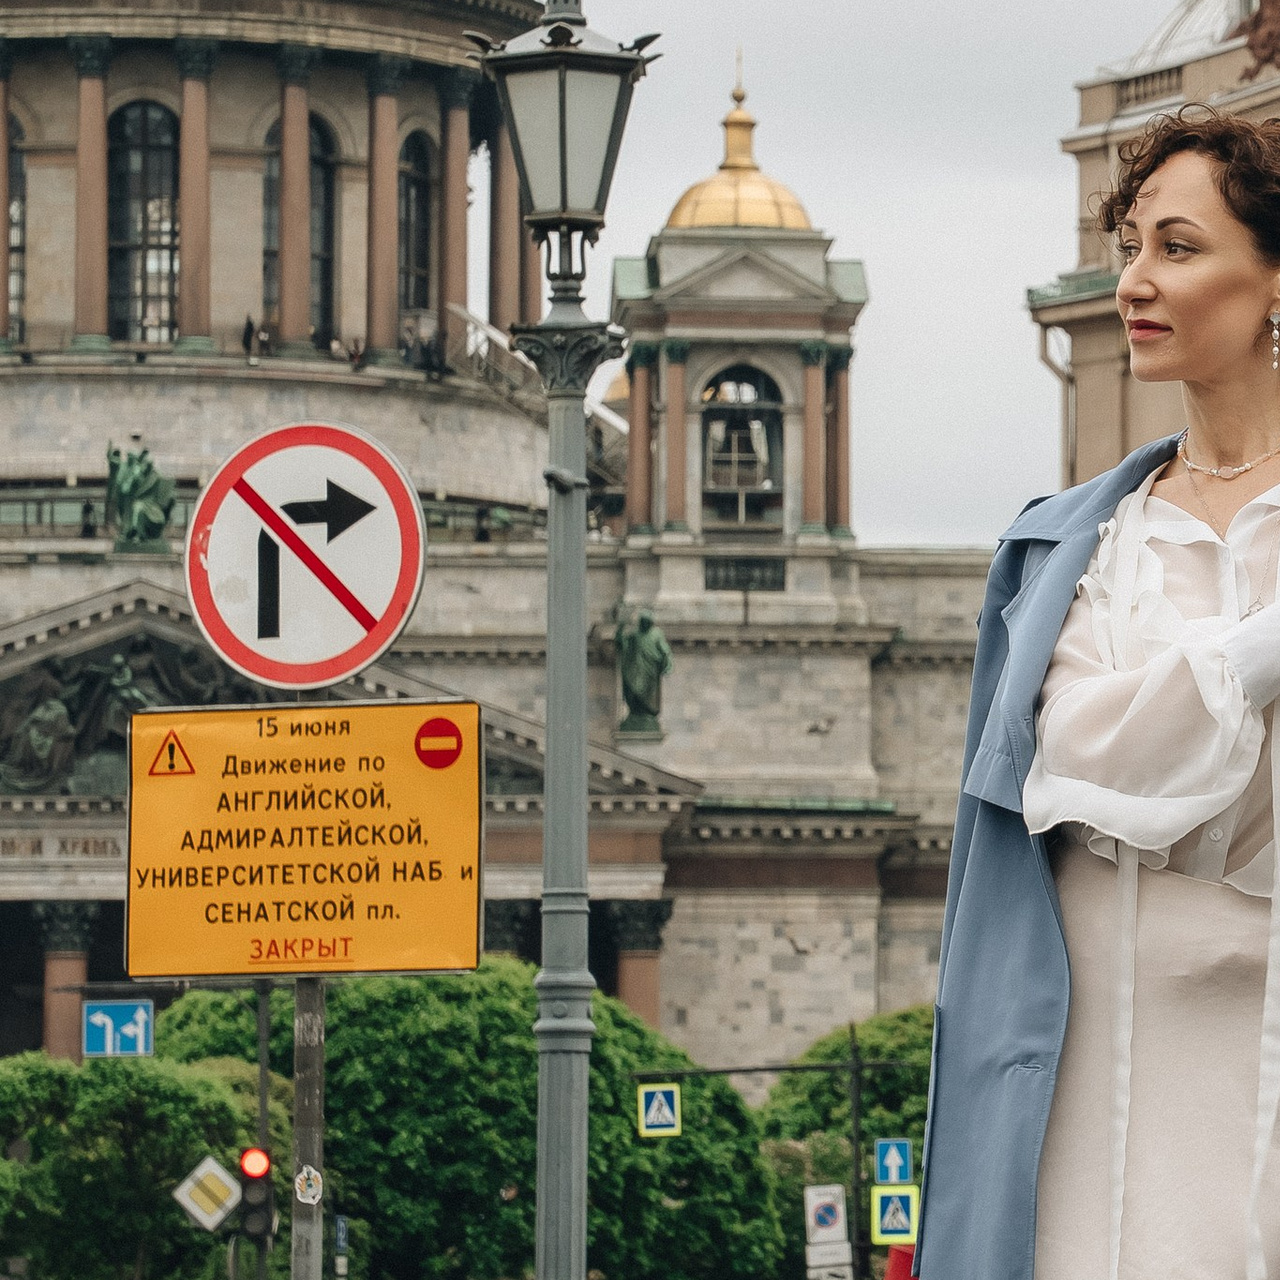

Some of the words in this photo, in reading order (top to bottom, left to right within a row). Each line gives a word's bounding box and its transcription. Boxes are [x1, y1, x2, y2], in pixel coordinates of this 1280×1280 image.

[256, 716, 279, 738] 15
[289, 719, 351, 737] июня
[221, 754, 346, 779] Движение
[358, 755, 386, 772] по
[216, 781, 392, 813] АНГЛИЙСКОЙ,
[180, 818, 429, 854] АДМИРАЛТЕЙСКОЙ,
[136, 856, 380, 889] УНИВЕРСИТЕТСКОЙ
[460, 865, 473, 880] и
[204, 893, 355, 925] СЕНАТСКОЙ
[367, 904, 400, 920] пл.
[250, 937, 353, 961] ЗАКРЫТ
